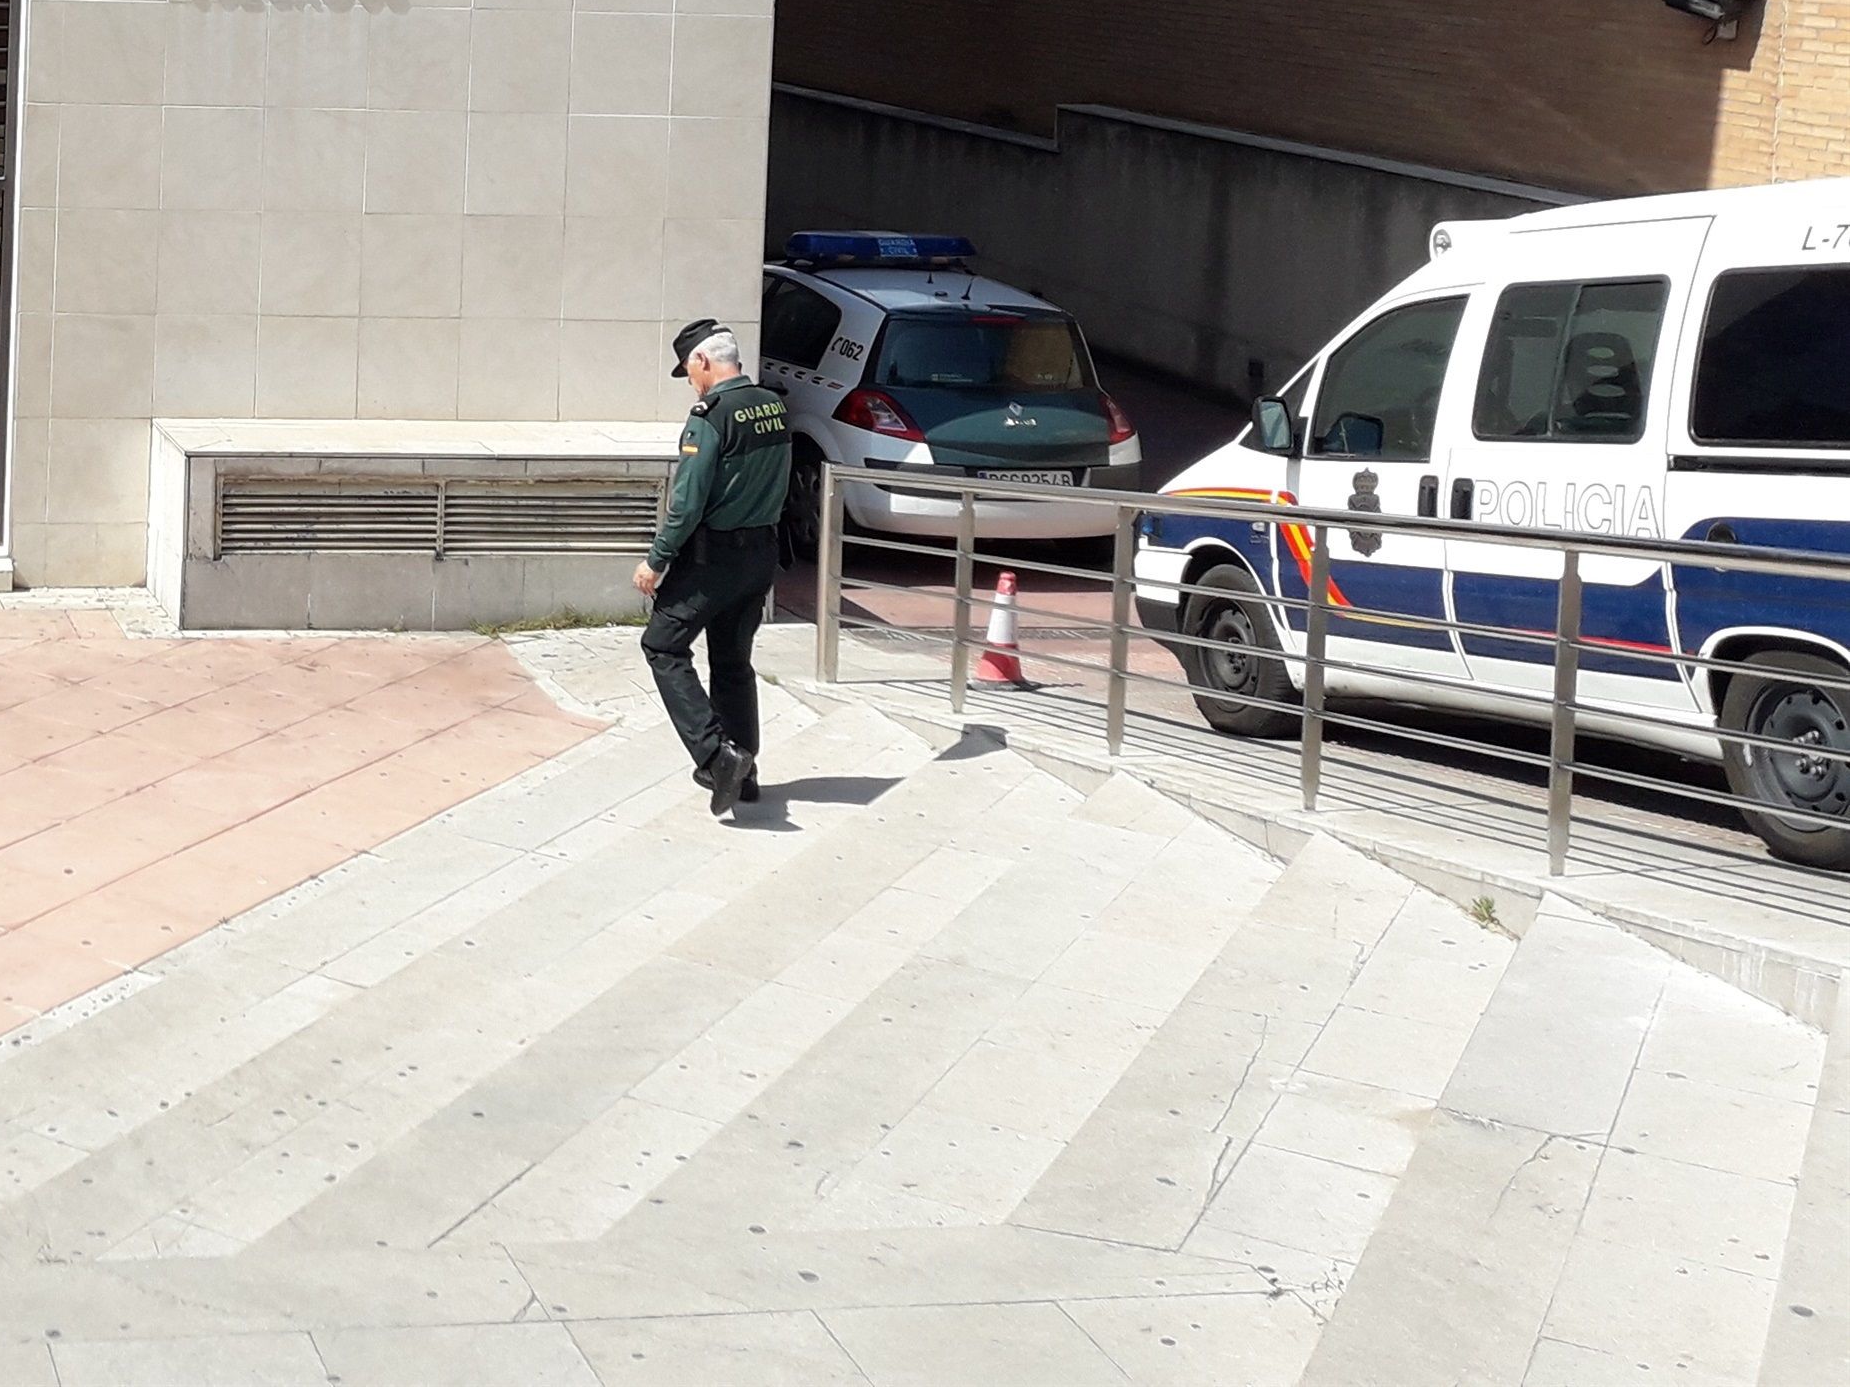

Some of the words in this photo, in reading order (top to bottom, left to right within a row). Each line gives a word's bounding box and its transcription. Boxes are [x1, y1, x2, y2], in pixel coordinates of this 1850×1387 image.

[1802, 224, 1850, 251] L-7
[839, 339, 864, 361] 062
[754, 417, 786, 434] CIVIL
[1474, 479, 1662, 539] POLICIA
